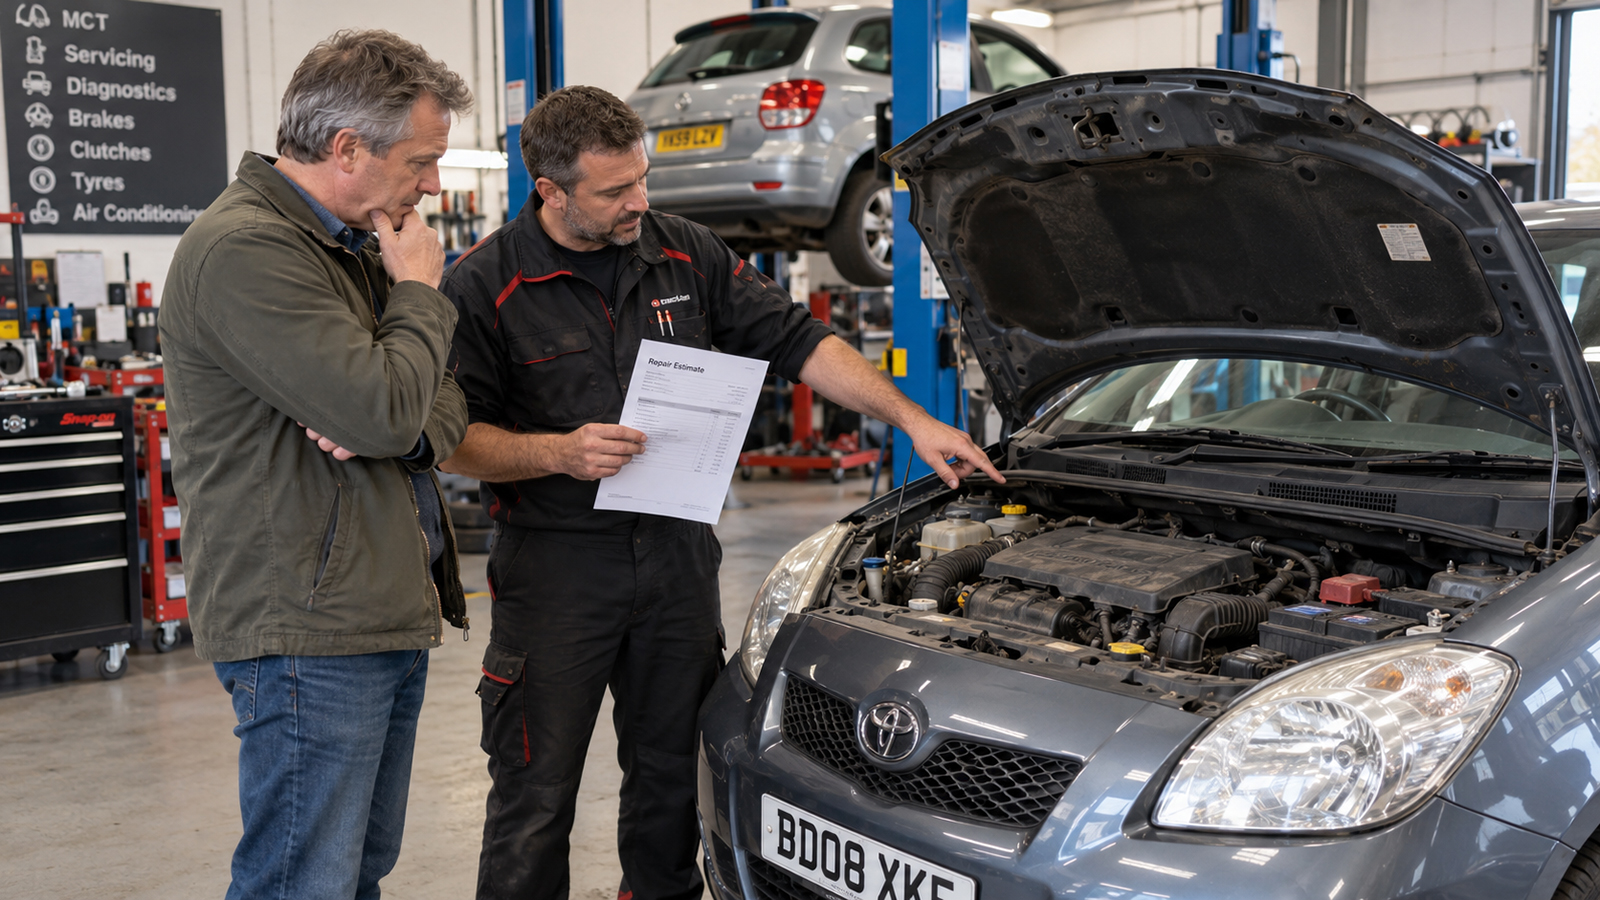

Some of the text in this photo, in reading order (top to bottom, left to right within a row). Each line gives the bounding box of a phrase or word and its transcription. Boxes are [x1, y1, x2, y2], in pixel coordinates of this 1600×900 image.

[62, 10, 109, 31] MCT
[64, 44, 156, 73] Servicing
[66, 76, 177, 102] Diagnostics
[68, 108, 135, 130] Brakes
[70, 140, 151, 162] Clutches
[71, 171, 125, 194] Tyres
[73, 203, 100, 222] Air
[648, 357, 705, 374] Repair Estimate
[60, 412, 116, 426] Snap-on
[777, 808, 865, 894] BD08
